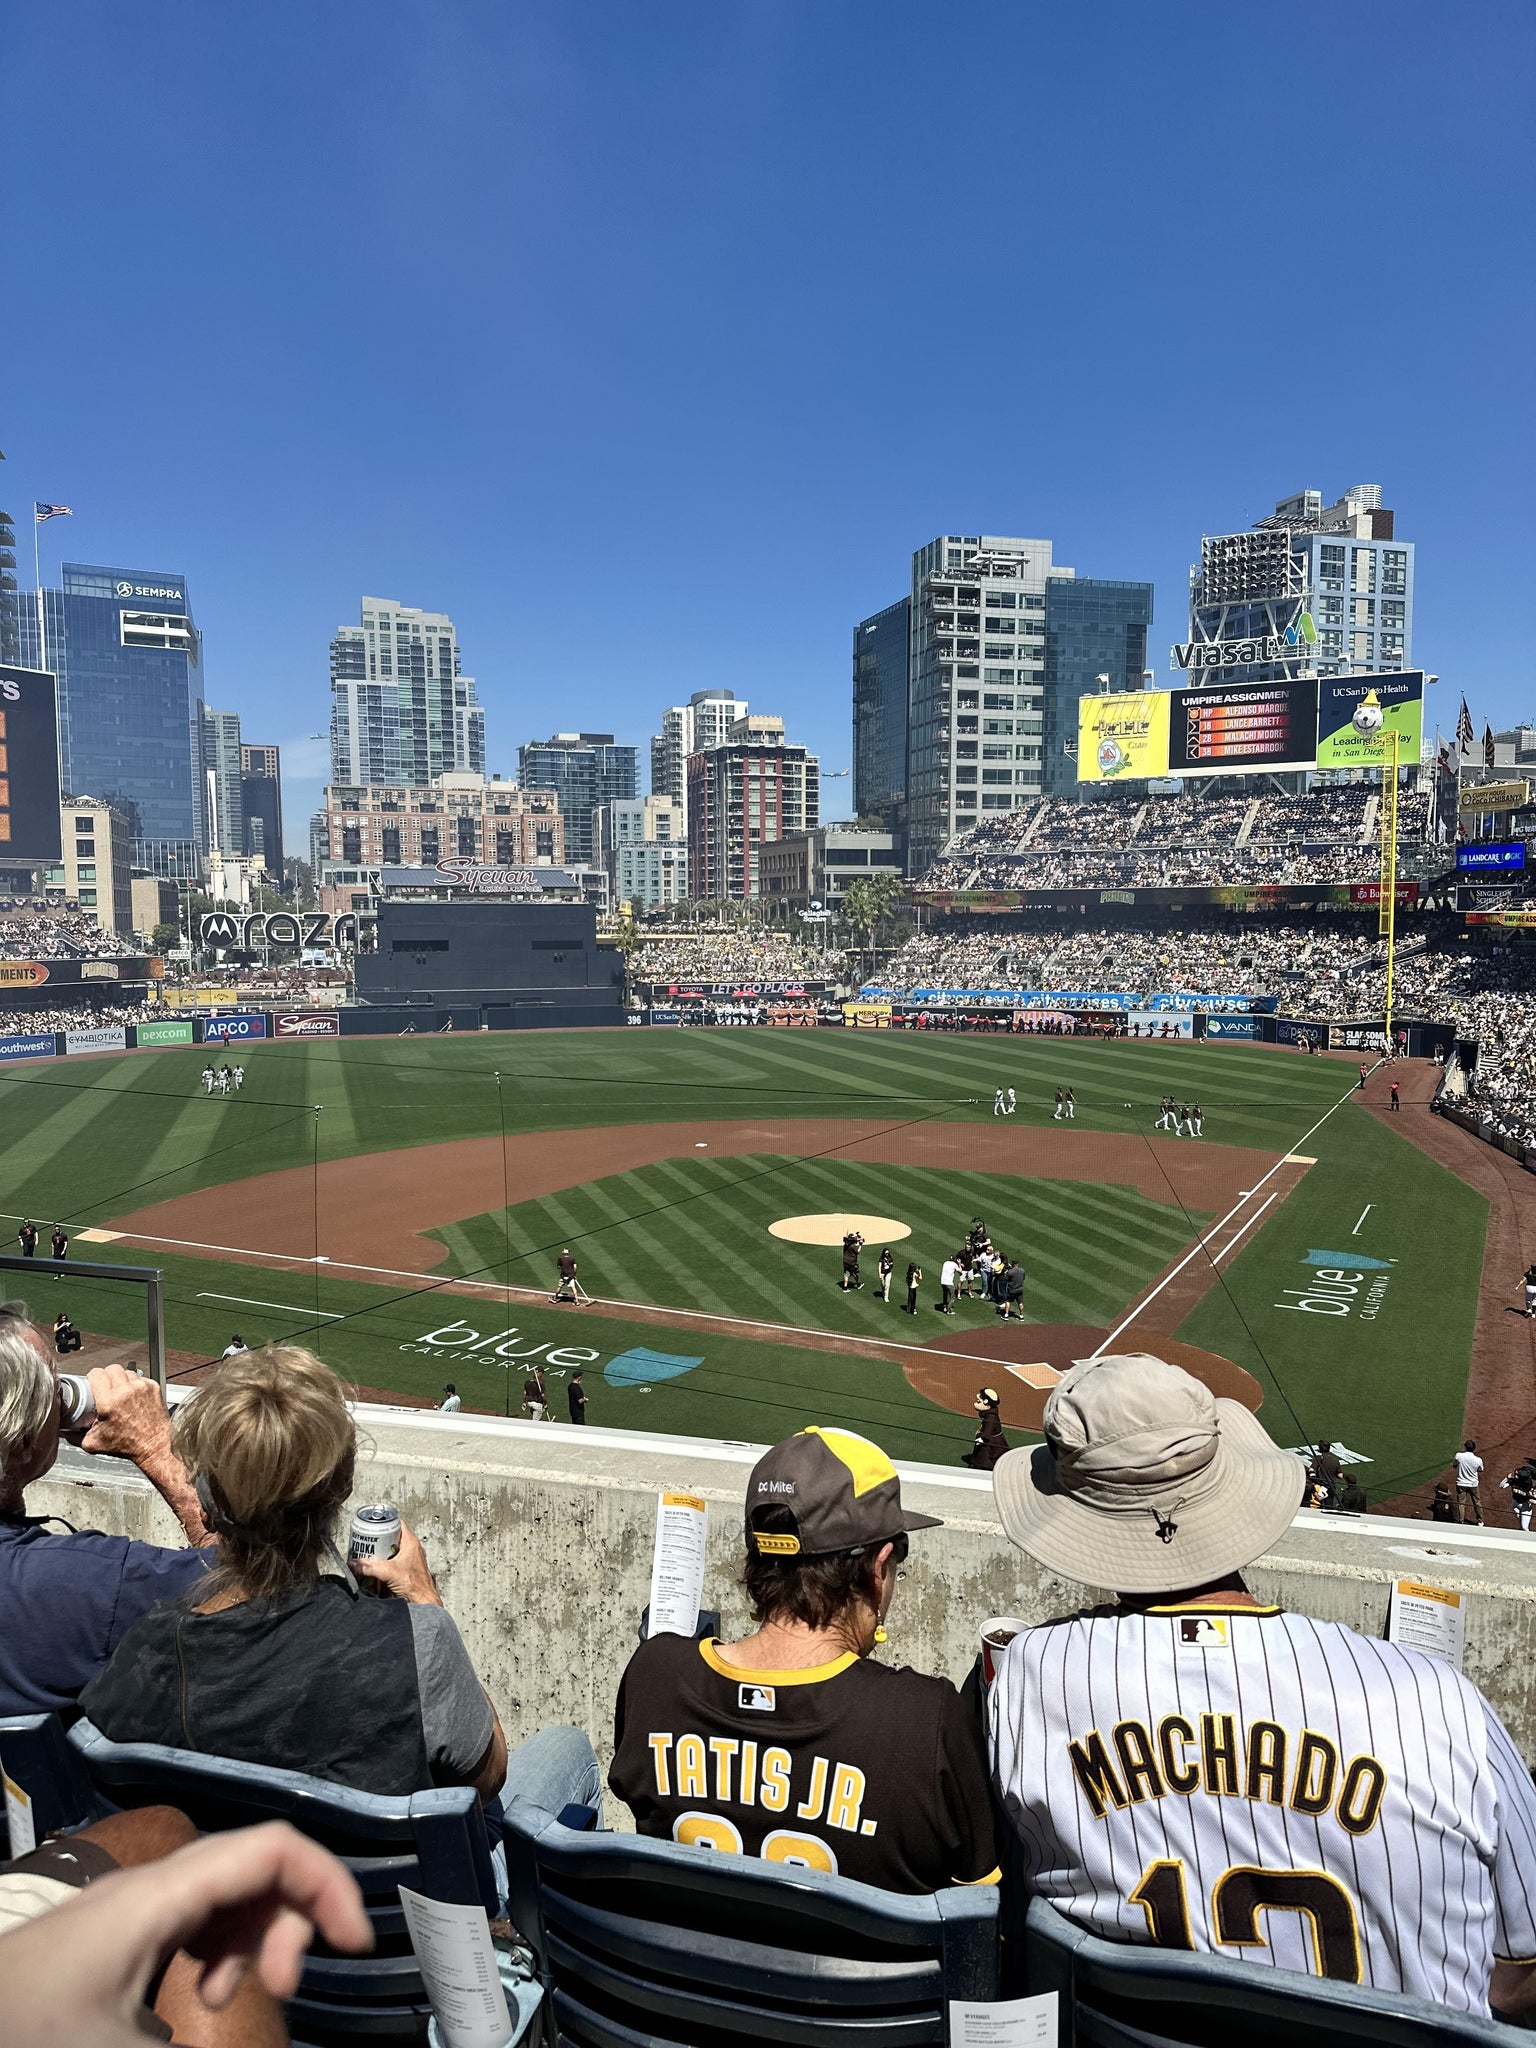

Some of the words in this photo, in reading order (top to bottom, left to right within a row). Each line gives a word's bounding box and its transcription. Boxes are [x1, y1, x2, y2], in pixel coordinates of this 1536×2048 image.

[135, 586, 182, 600] SEMPRA
[1175, 637, 1273, 668] Viasat
[1332, 687, 1345, 697] UC
[1346, 687, 1360, 696] San
[1384, 684, 1409, 694] Health
[1182, 695, 1223, 706] UMPIRE
[1203, 708, 1213, 717] HP
[1225, 702, 1257, 716] ALFONSO
[1204, 722, 1212, 731] 1B
[1225, 718, 1247, 729] LANCE
[1249, 716, 1280, 727] BARRETT
[1202, 734, 1212, 743] 2B
[1225, 731, 1257, 741] MALACHI
[1258, 729, 1284, 739] MOORE
[1202, 747, 1212, 756] 3B
[1224, 744, 1242, 755] MIKE
[1243, 742, 1285, 753] ESTABROOK
[1344, 749, 1360, 757] San
[1468, 853, 1499, 862] LANDCARE
[434, 855, 537, 892] Sycuan
[1100, 891, 1134, 904] PADRES
[243, 912, 357, 948] razr
[81, 962, 119, 979] PADRES
[712, 984, 741, 994] LET'S
[744, 983, 761, 994] GO
[764, 982, 805, 993] PLACES
[279, 1016, 333, 1035] Sycuan
[627, 1016, 641, 1025] 396
[1223, 1023, 1261, 1032] VANDA
[207, 1021, 249, 1036] ARCO
[1273, 1269, 1364, 1316] blue
[1359, 1275, 1390, 1320] CALIFORNIA
[415, 1319, 600, 1367] blue
[1067, 1712, 1387, 1836] MACHADO
[649, 1732, 793, 1812] TATIS
[797, 1756, 878, 1836] JR.
